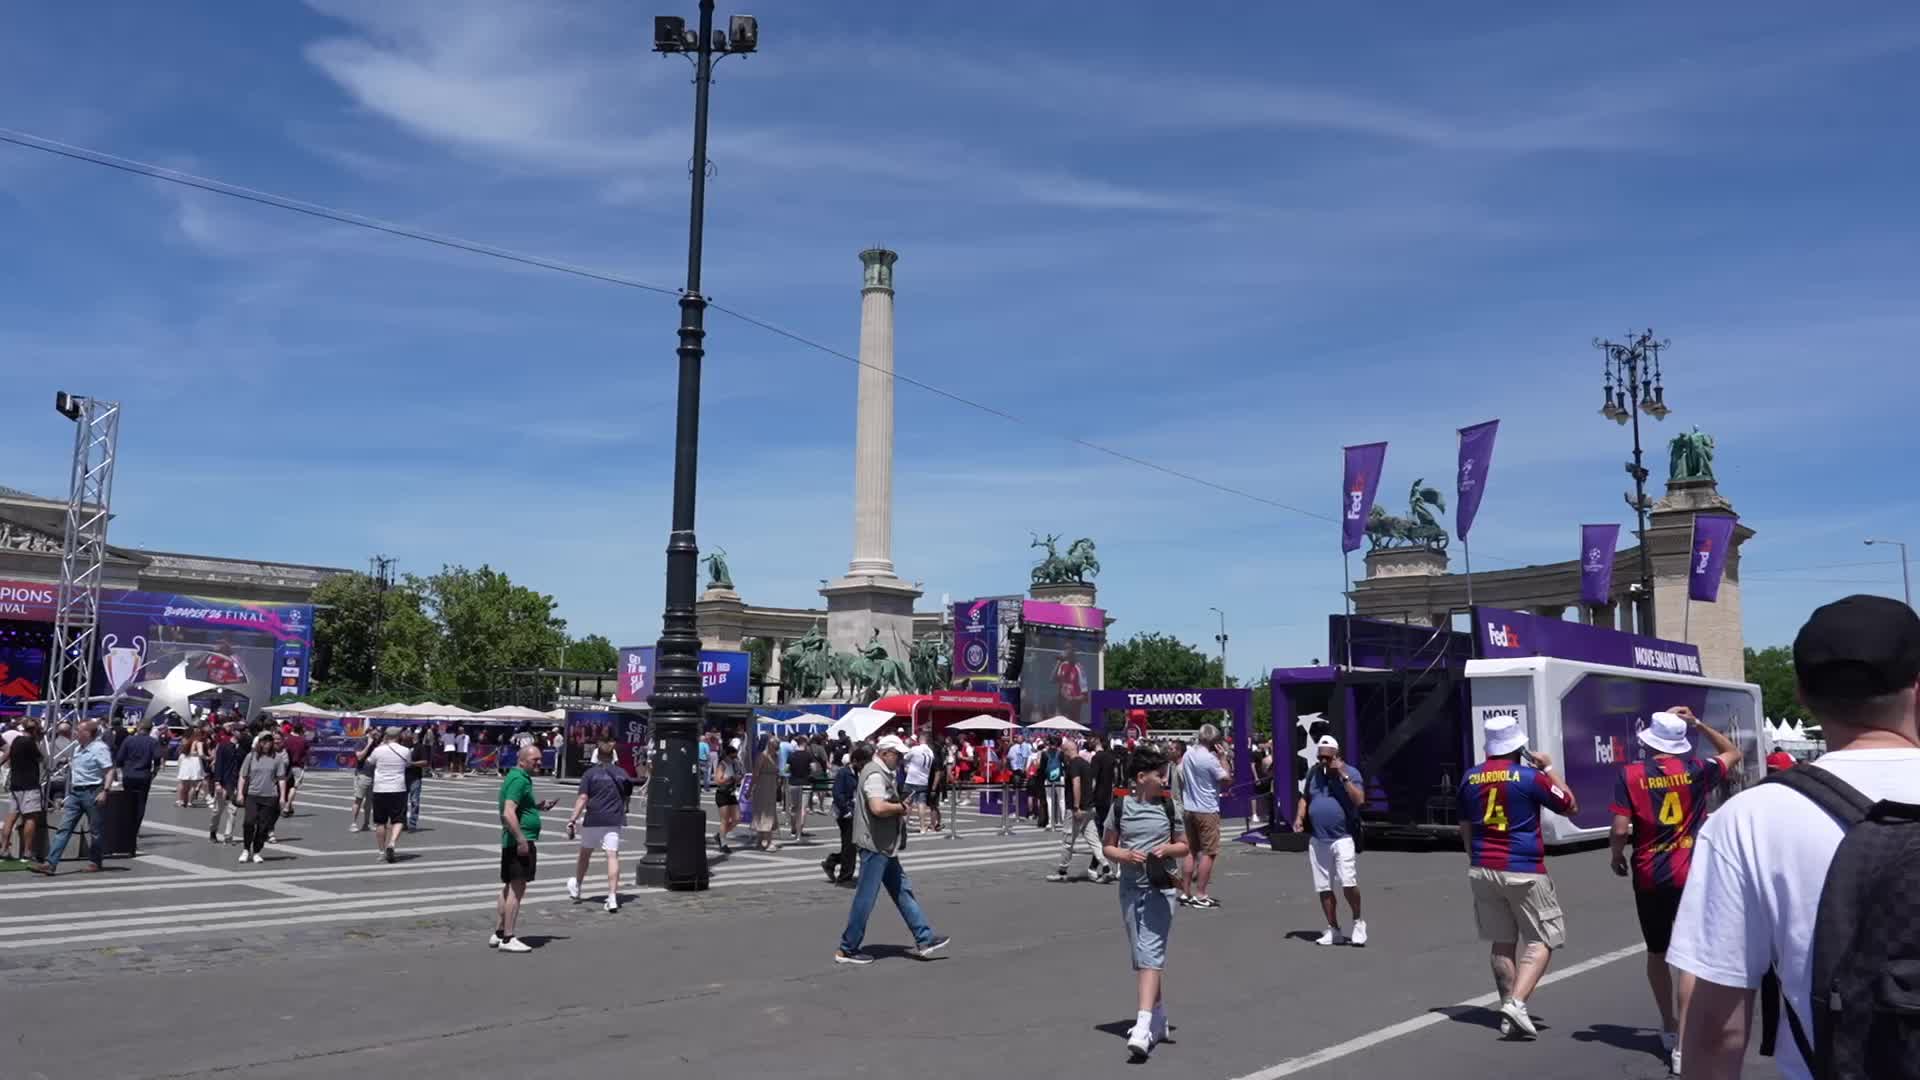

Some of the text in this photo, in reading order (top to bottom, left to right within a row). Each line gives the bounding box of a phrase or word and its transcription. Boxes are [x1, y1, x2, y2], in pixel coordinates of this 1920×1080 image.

[0, 587, 53, 604] PIONS
[225, 610, 266, 623] FINAL
[1488, 622, 1520, 648] FedEx
[1634, 646, 1656, 667] MOVE
[1127, 693, 1203, 706] TEAMWORK
[1594, 735, 1627, 764] FedEx
[1468, 769, 1521, 785] GUARDIOLA
[1483, 787, 1508, 831] 4
[1659, 791, 1684, 825] 4
